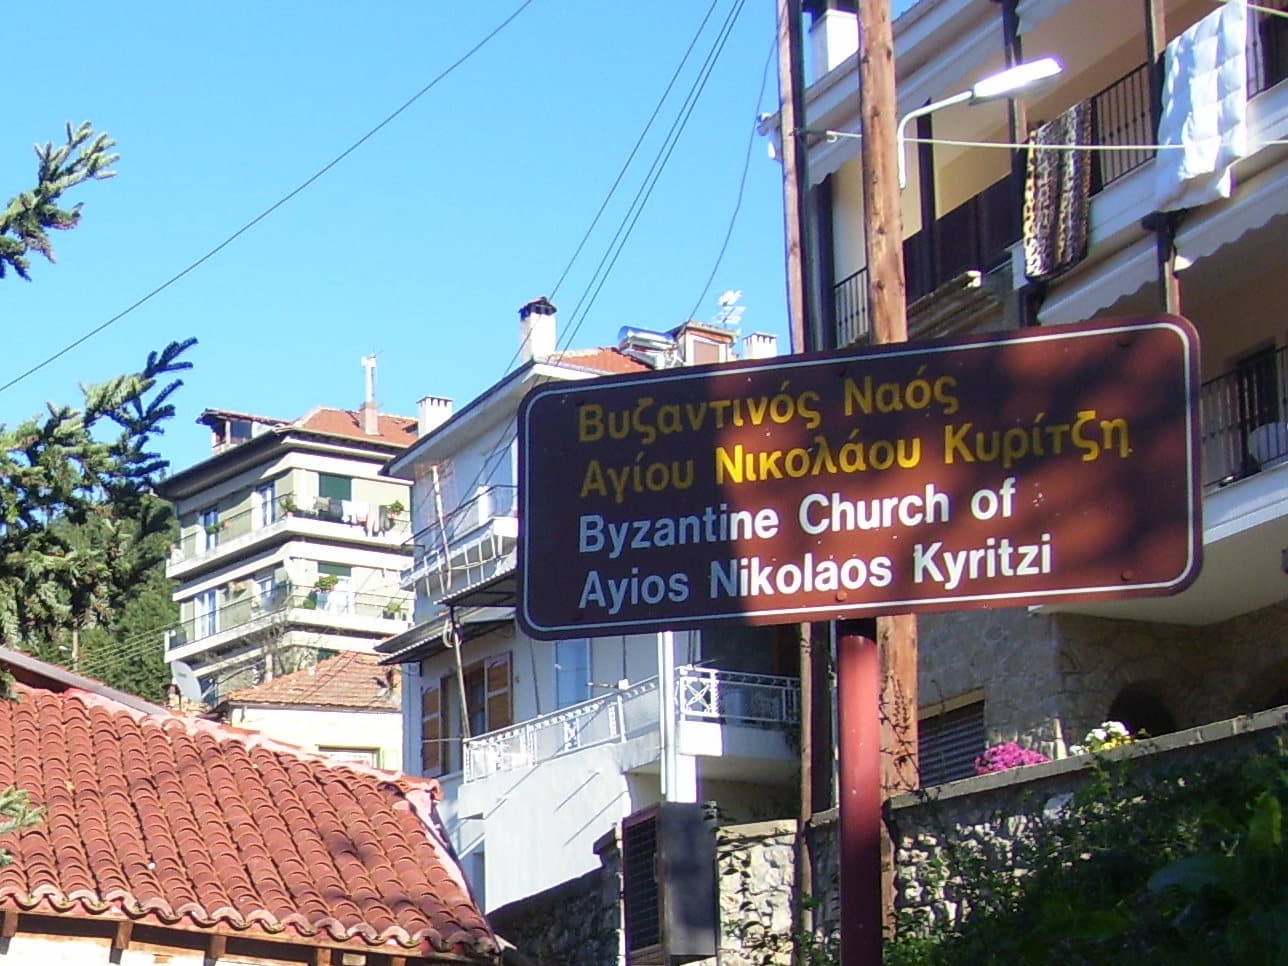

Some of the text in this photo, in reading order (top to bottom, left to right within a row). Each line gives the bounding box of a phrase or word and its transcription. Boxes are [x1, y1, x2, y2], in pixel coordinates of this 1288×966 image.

[578, 374, 958, 445] Βυζαντινός Ναός
[580, 410, 1128, 502] Αγίου Νικολάου Κυρίτζη
[579, 478, 1016, 558] Byzantine Church of
[579, 534, 1052, 615] Ayios Nikolaos Kyritzi
